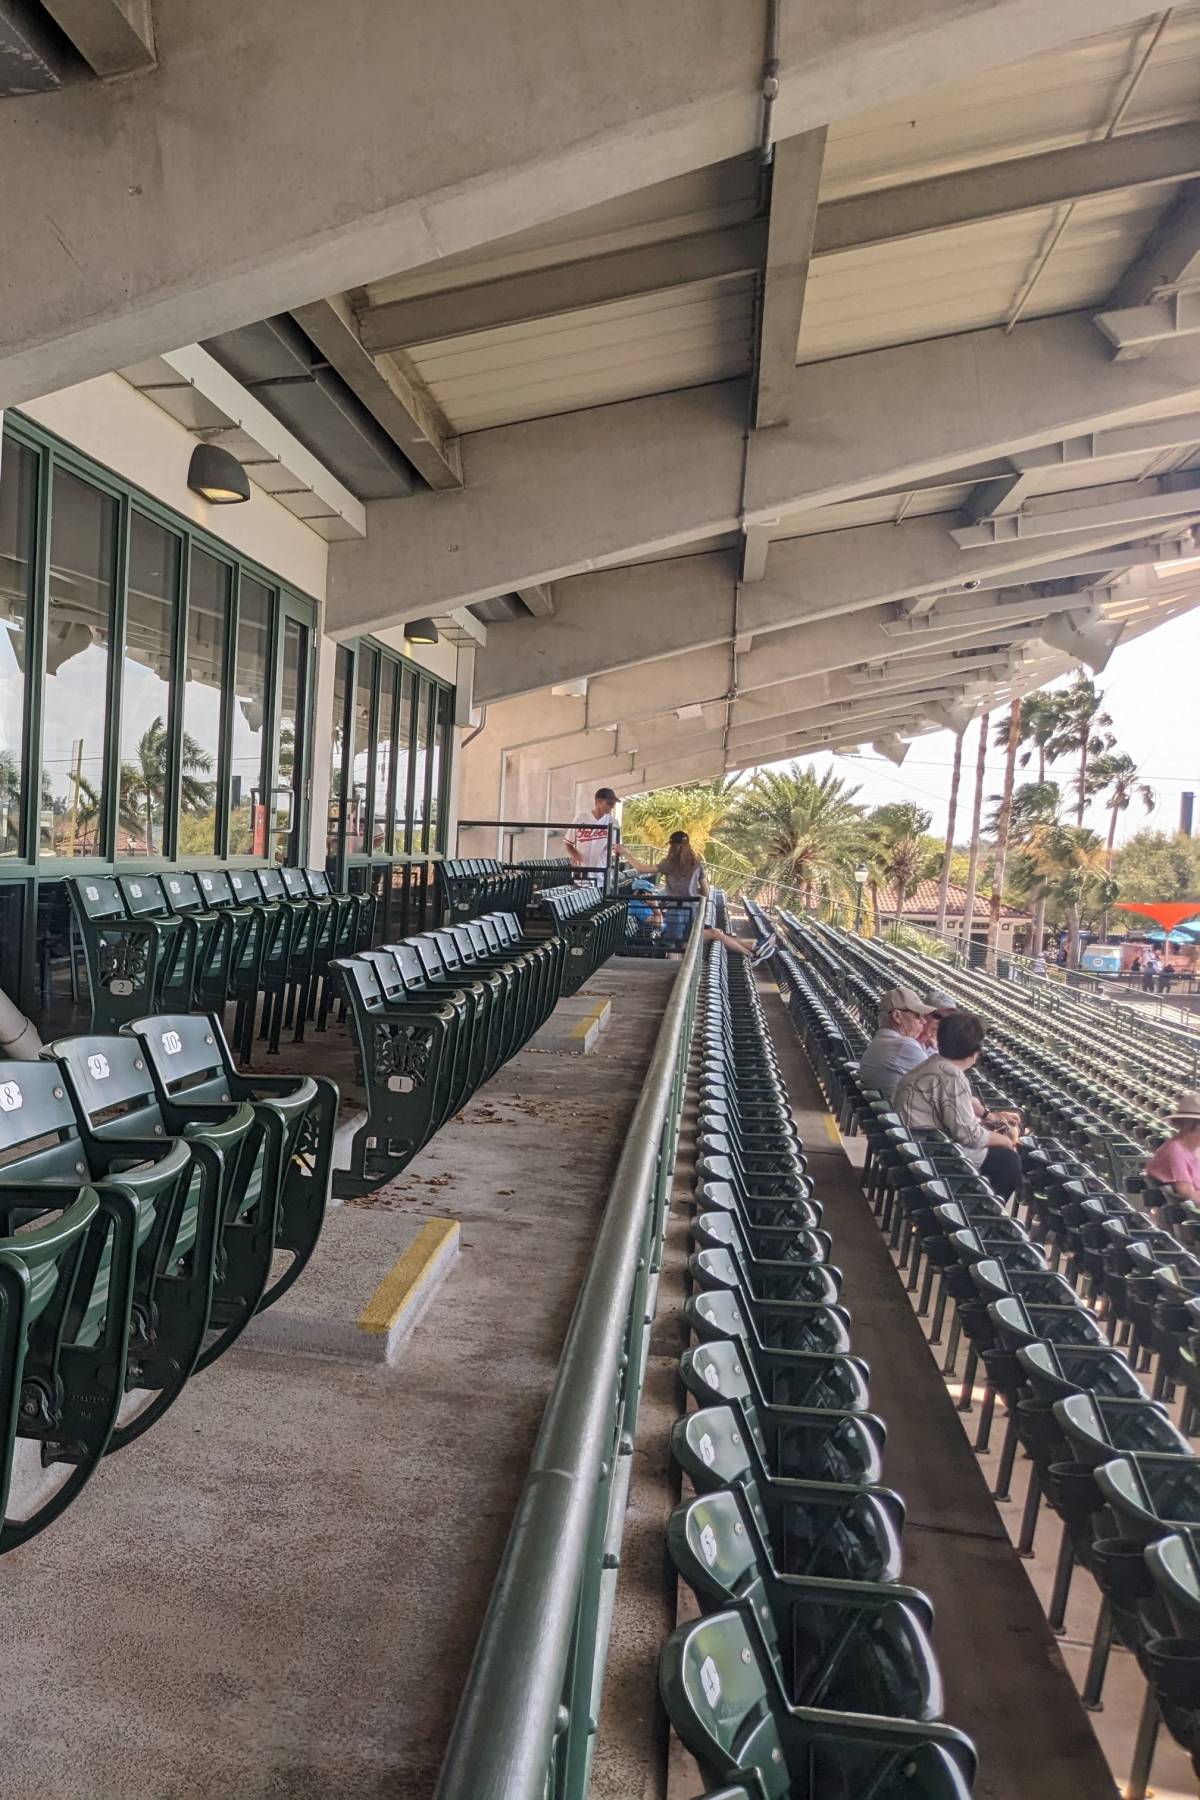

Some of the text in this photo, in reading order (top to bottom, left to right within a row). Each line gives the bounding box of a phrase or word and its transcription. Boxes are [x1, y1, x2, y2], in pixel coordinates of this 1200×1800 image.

[118, 982, 125, 993] 2
[165, 1035, 178, 1051] 10
[93, 1058, 102, 1075] 9
[398, 1078, 403, 1090] 1
[3, 1086, 15, 1106] 8
[705, 1668, 716, 1693] 4
